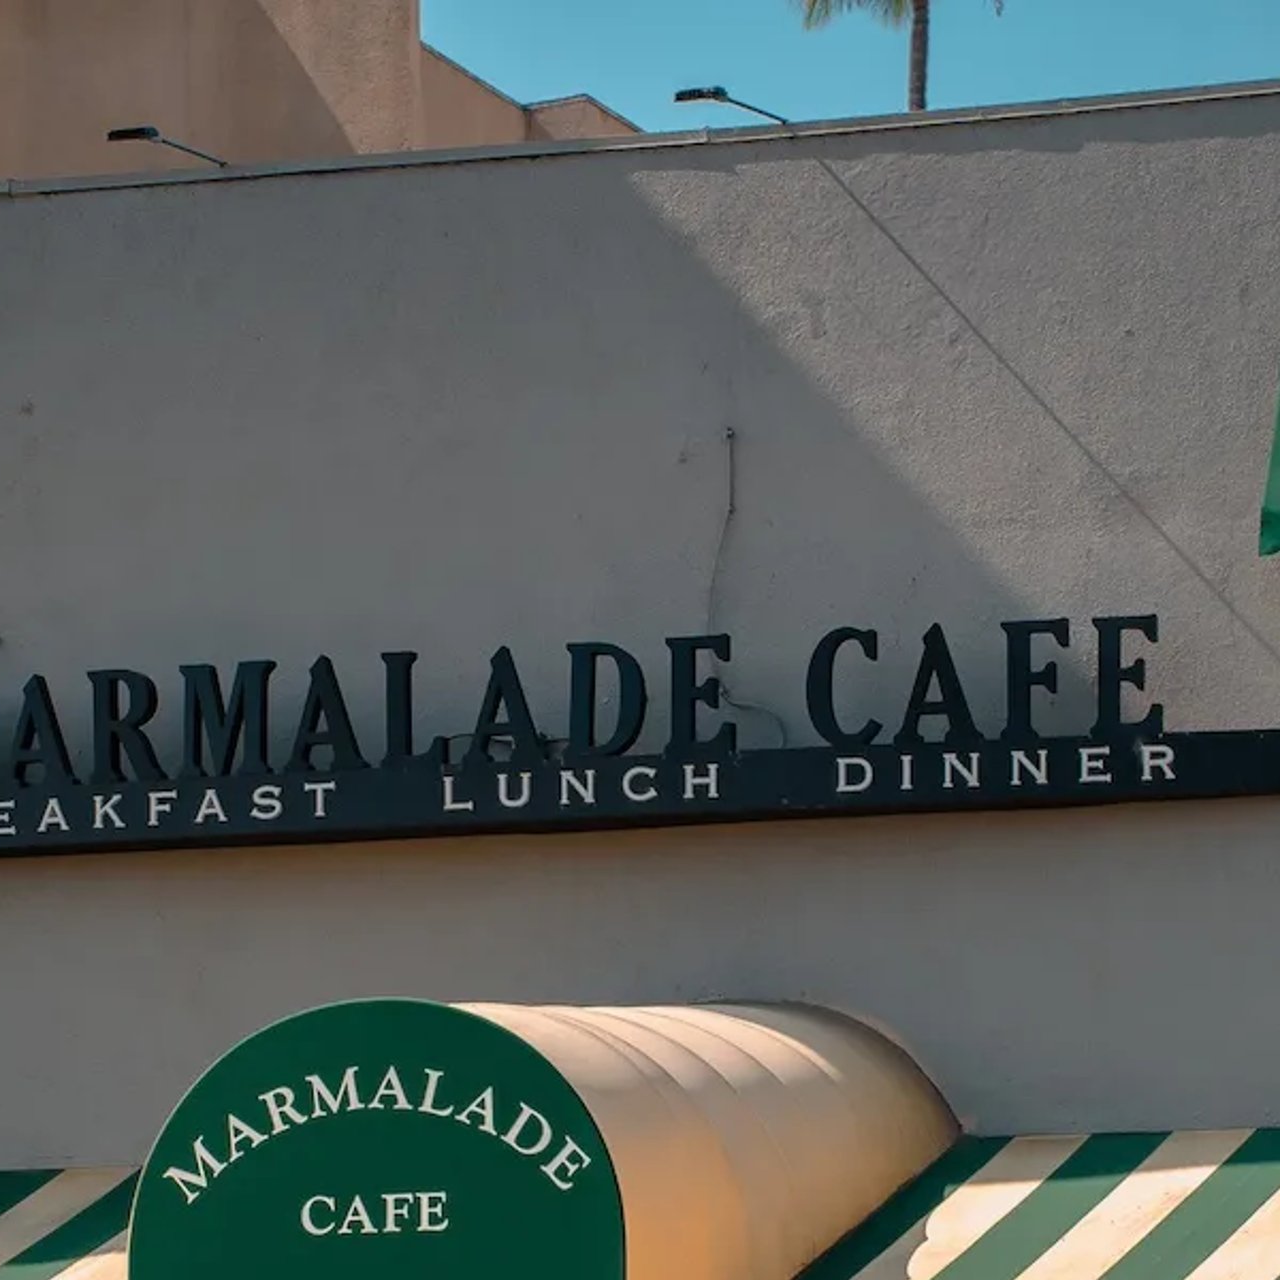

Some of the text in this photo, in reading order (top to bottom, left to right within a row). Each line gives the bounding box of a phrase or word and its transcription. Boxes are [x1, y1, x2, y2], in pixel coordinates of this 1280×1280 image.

[805, 613, 1164, 749] CAFE
[442, 762, 720, 812] LUNCH
[836, 743, 1177, 793] DINNER
[162, 1065, 592, 1205] MARMALADE
[300, 1191, 450, 1236] CAFE
